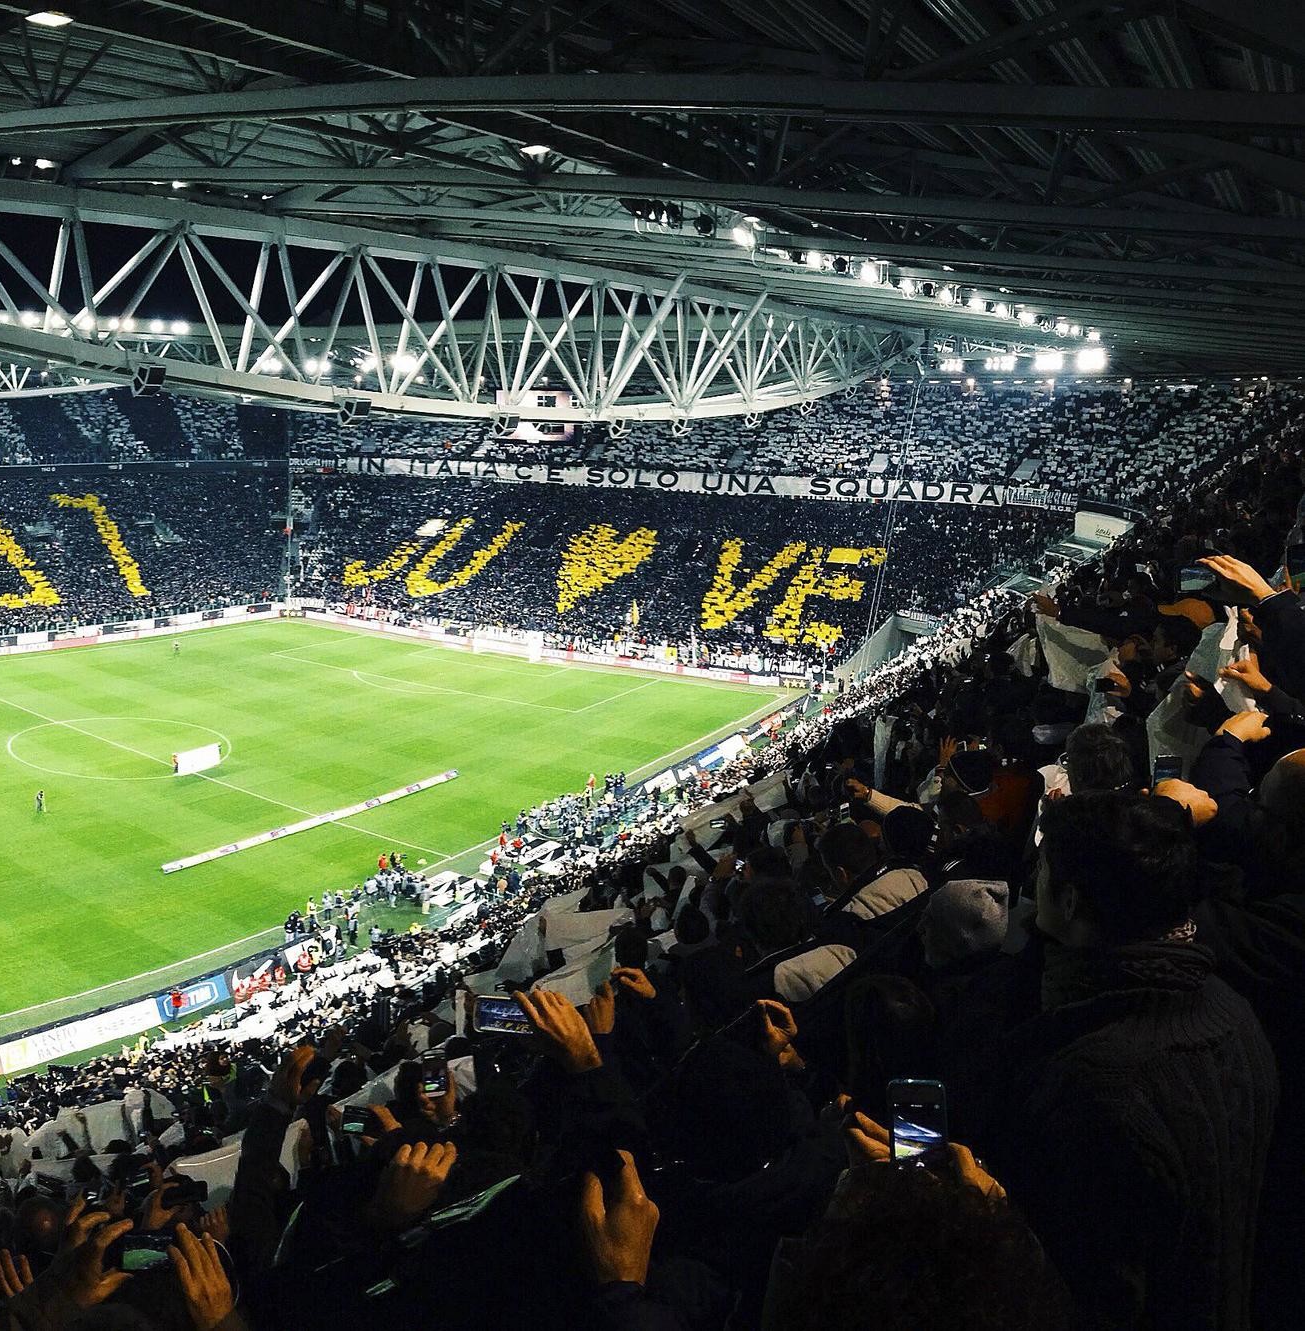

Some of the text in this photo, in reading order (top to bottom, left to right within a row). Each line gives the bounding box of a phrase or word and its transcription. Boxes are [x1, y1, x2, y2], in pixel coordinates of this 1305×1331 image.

[358, 456, 385, 474] IN
[409, 457, 500, 478] ITALIA
[586, 467, 680, 489] SOLO
[700, 473, 777, 496] UNA
[808, 477, 1002, 506] SQUADRA
